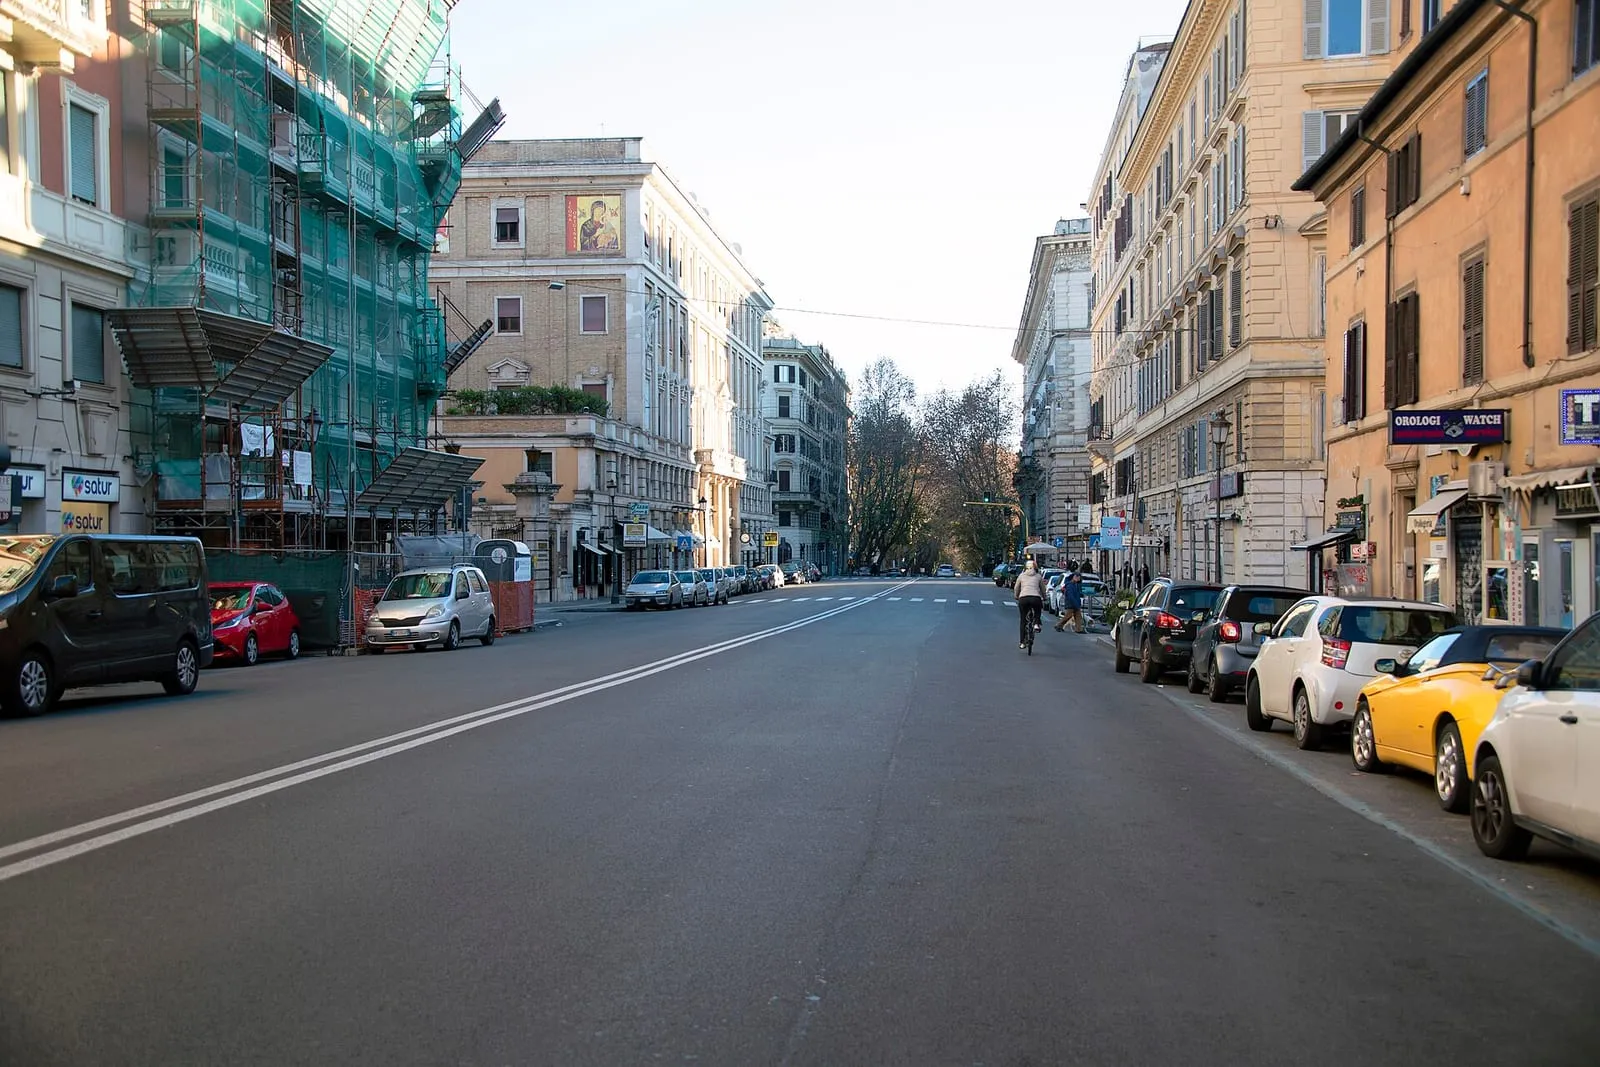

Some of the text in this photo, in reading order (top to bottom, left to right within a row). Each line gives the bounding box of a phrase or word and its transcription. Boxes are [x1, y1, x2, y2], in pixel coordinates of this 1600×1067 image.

[1395, 414, 1502, 426] OROLOGI WATCH
[84, 477, 112, 496] satur
[75, 512, 103, 530] satur
